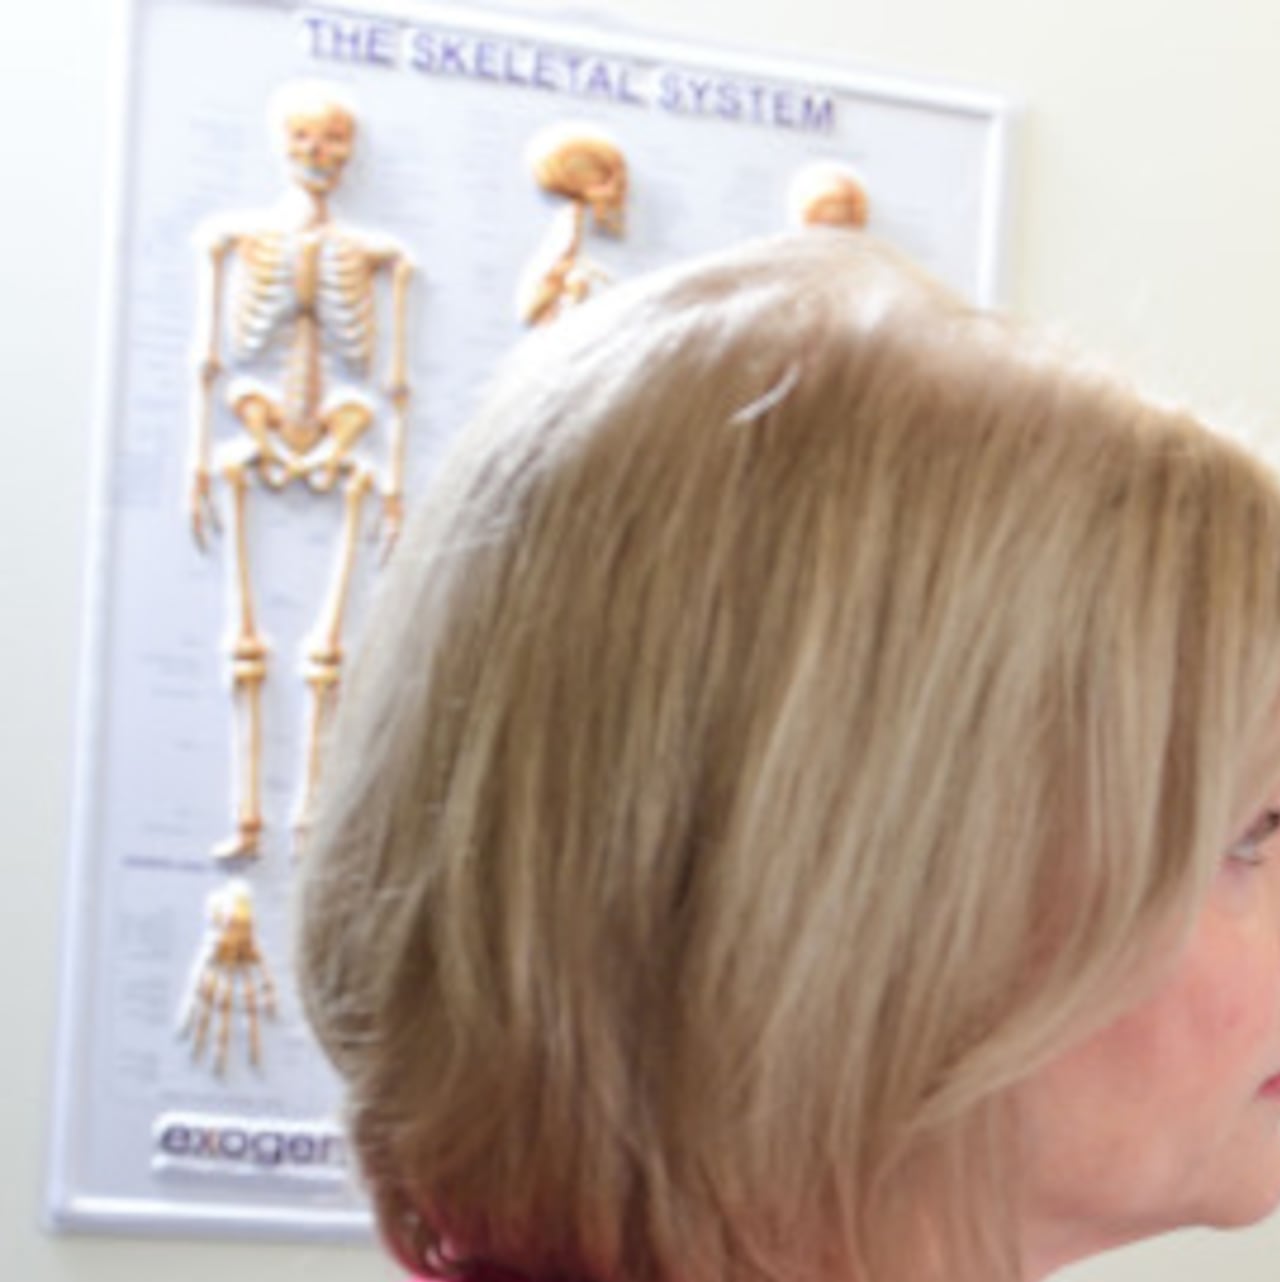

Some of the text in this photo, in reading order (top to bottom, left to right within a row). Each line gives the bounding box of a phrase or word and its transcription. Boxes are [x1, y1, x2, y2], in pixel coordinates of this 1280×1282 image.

[303, 17, 838, 134] THE SKELETAL SYSTEM
